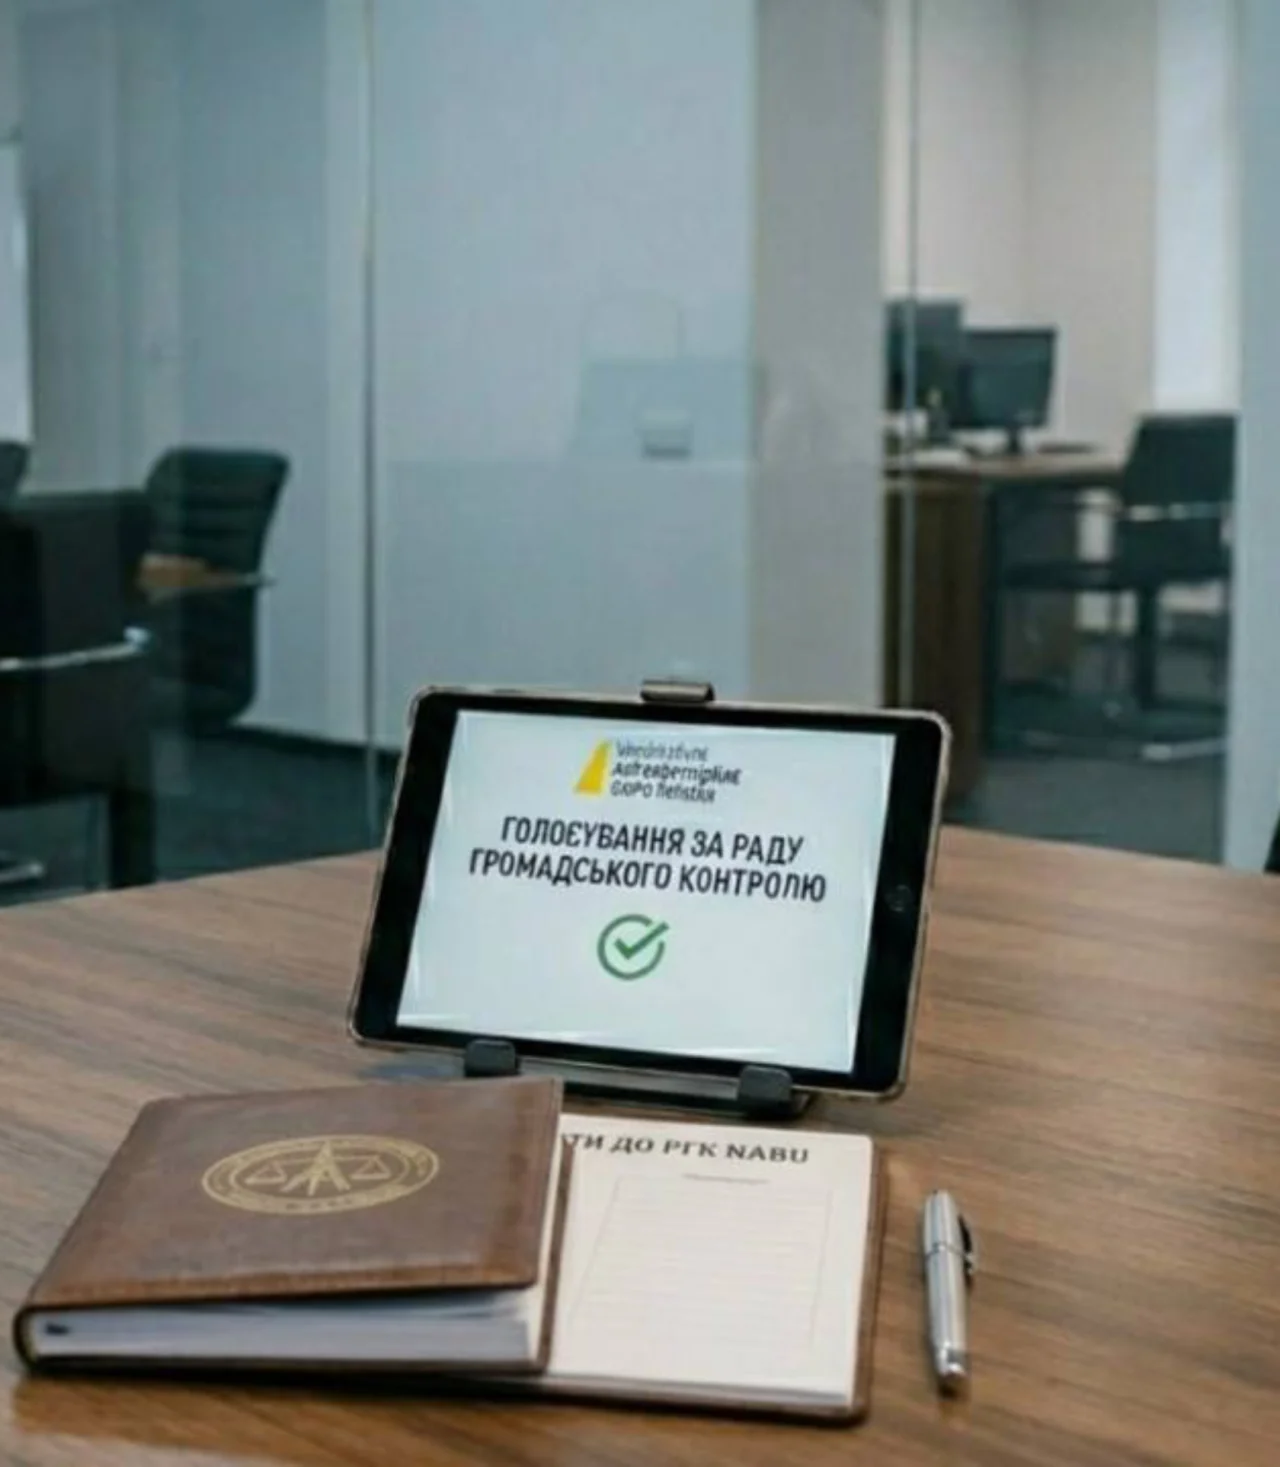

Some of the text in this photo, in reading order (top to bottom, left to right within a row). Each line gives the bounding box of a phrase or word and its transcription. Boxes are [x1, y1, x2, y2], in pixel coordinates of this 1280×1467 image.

[693, 829, 725, 859] ЗА
[731, 833, 805, 866] РАДУ
[469, 847, 672, 890] ГРОМАДСЬКОГО
[725, 1142, 810, 1165] NABU
